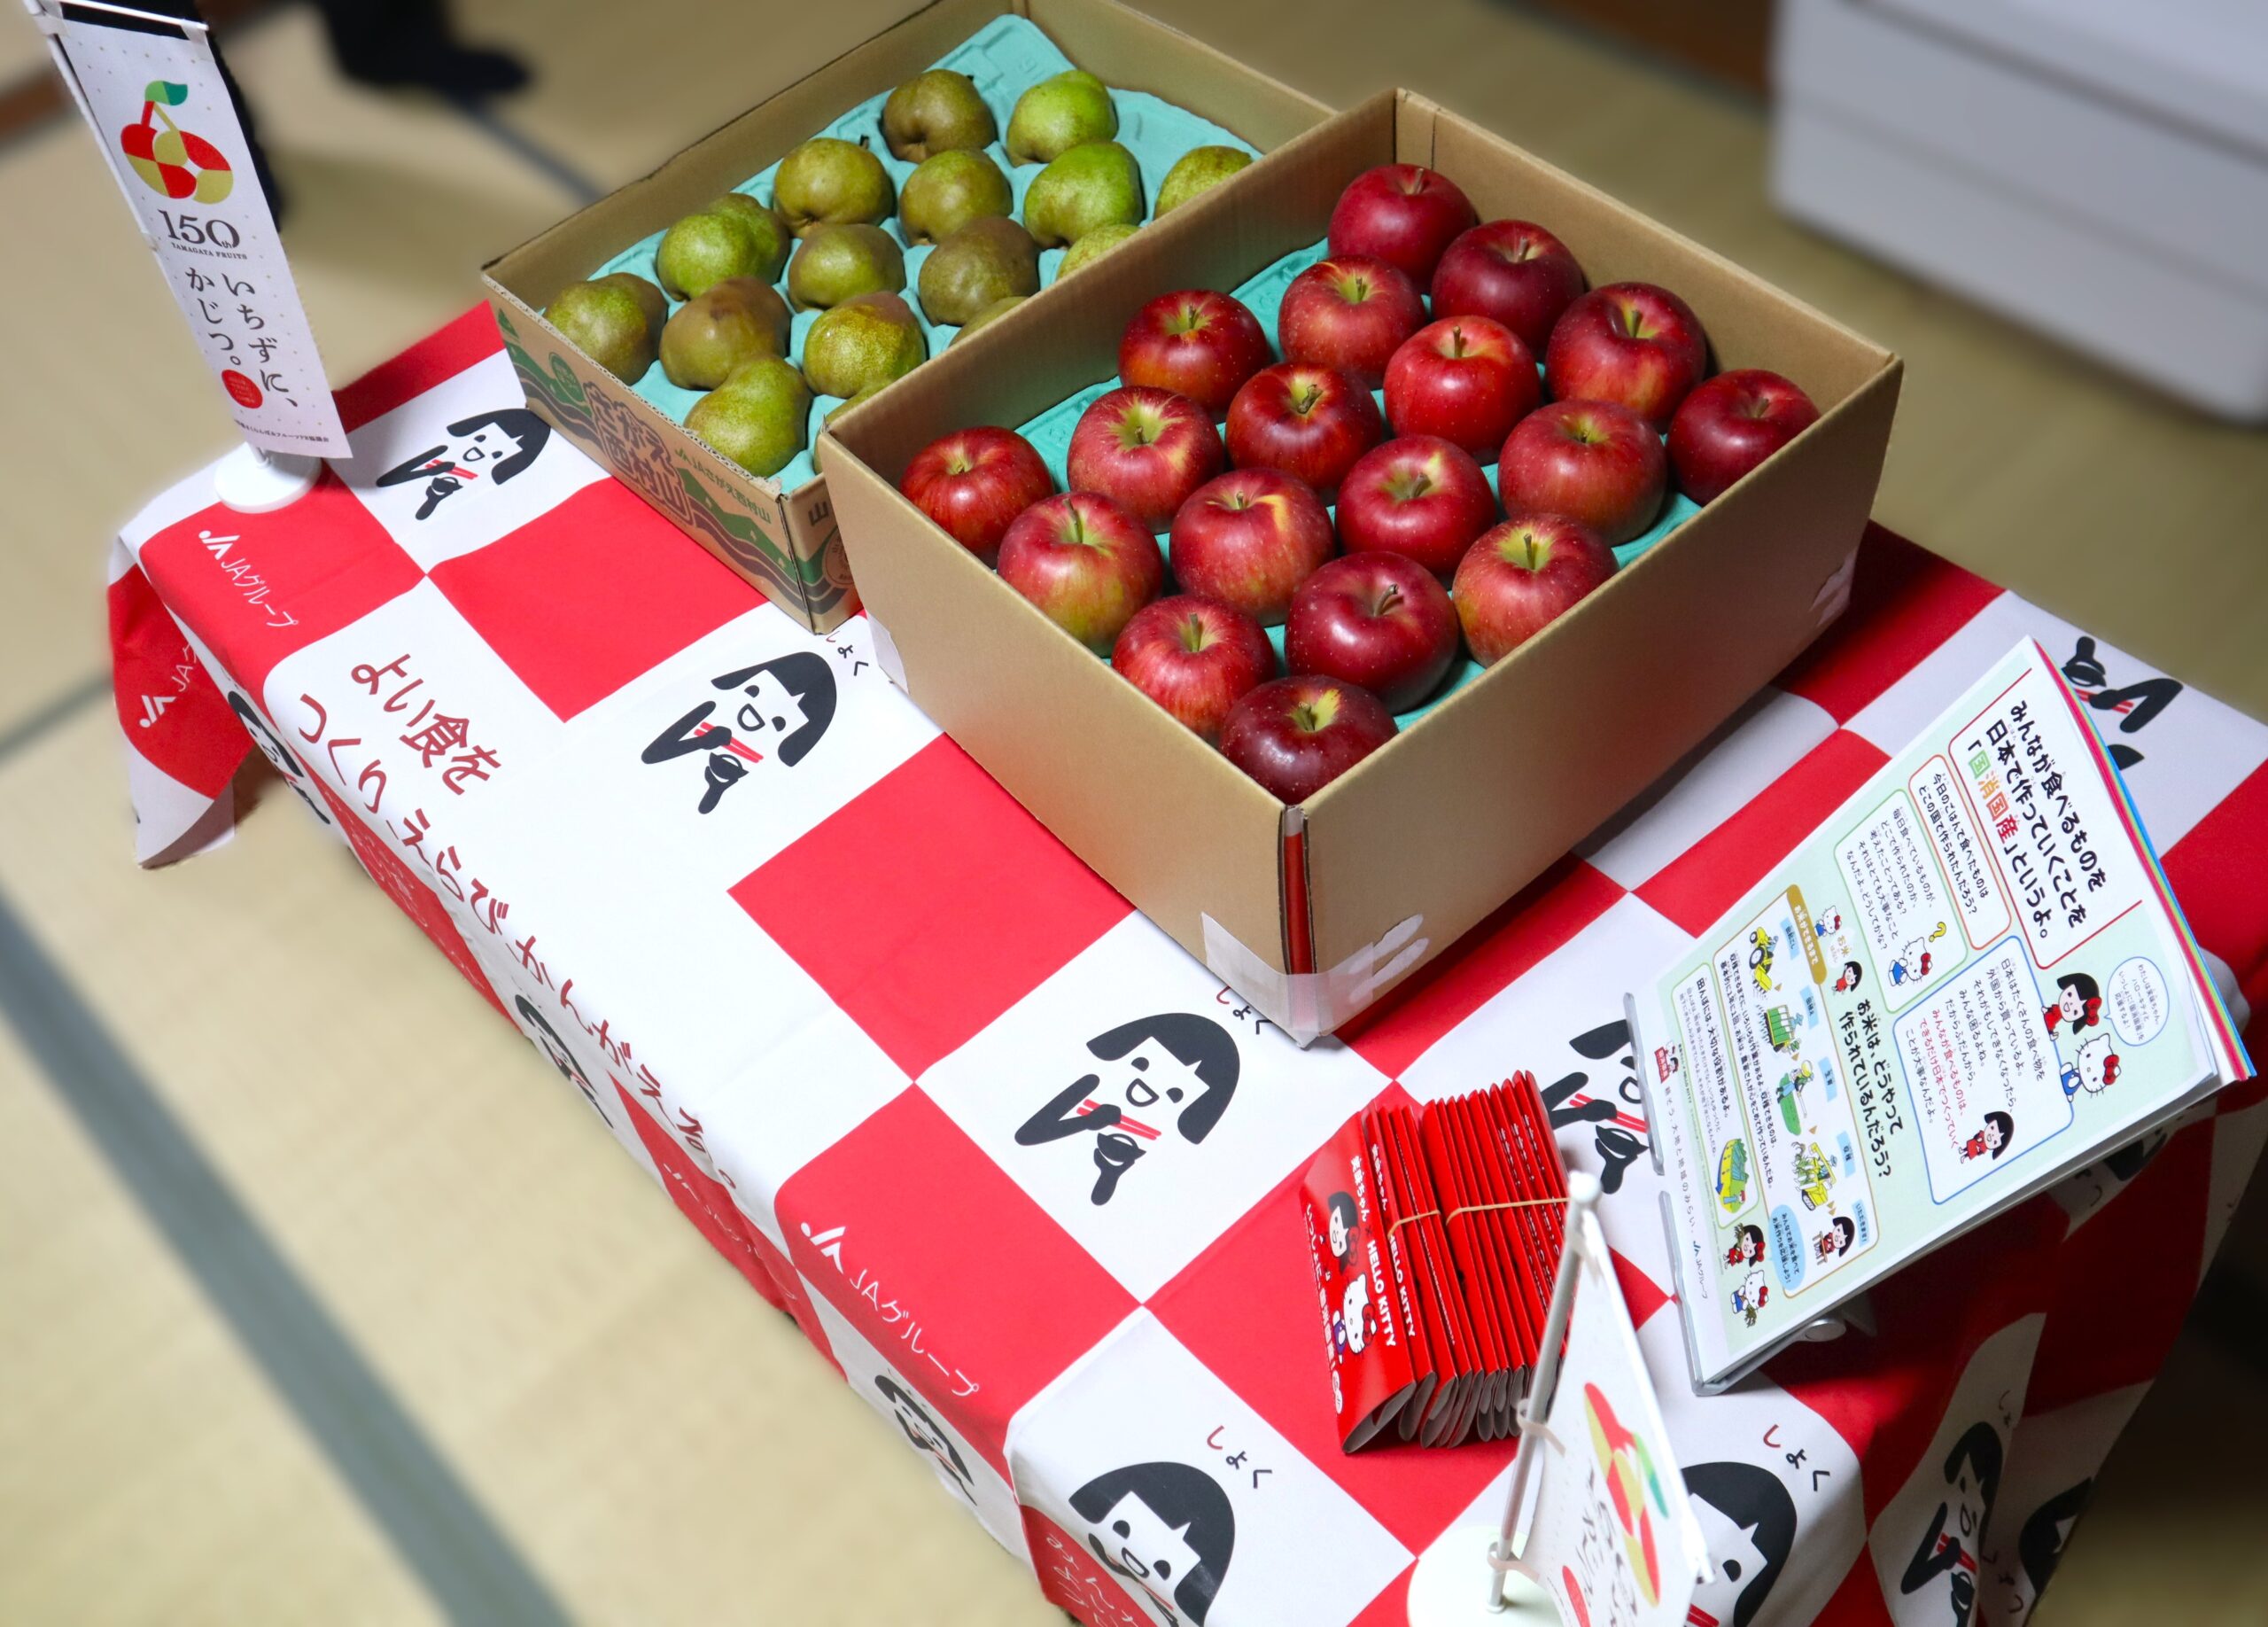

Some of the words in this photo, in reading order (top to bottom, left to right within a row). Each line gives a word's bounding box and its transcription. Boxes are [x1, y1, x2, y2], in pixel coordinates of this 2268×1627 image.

[171, 242, 214, 257] YAMAGATA
[216, 251, 248, 260] FRUITS
[185, 267, 242, 366] かじつ。
[221, 273, 298, 407] いちずに、
[221, 558, 299, 627] JAグループ
[351, 653, 502, 796] よい食を
[1931, 770, 1989, 899] 今日のごはんで食べたものは
[1968, 738, 2056, 939] 「国消国産」というよ。
[1984, 718, 2088, 930] 日本で作っていくことを
[2008, 697, 2109, 895] みんなが食べるものを
[1857, 837, 1899, 941] それはとても大事なこと
[1880, 818, 1920, 909] どこで作られたのか、
[1891, 806, 1936, 908] 毎日食べているものが、
[1794, 903, 1818, 967] お米ができるまで
[1945, 997, 1977, 1087] だからふだんから、
[1957, 987, 1988, 1068] みんな困るよね。
[1971, 977, 2018, 1114] それがもしできなくなったら、
[1985, 966, 2026, 1078] 外国から買っているよ。
[2000, 957, 2046, 1082] 日本はたくさんの食べ物を
[2131, 977, 2149, 1022] ハローキティと
[1837, 1008, 1892, 1181] 作られているんだろう？
[1855, 995, 1904, 1136] お米は、どうやって
[1905, 1027, 1937, 1125] ことが大事なんだよ。
[1918, 1016, 1960, 1148] できるだけ日本でつくっていく
[1930, 1007, 1969, 1117] みんなが食べるものは、
[850, 1269, 979, 1397] JAグループ
[1367, 1239, 1384, 1294] HELLO
[1378, 1297, 1396, 1347] KITTY
[1399, 1286, 1416, 1337] KITTY
[1207, 1425, 1272, 1489] しょく
[1763, 1424, 1830, 1492] しょく
